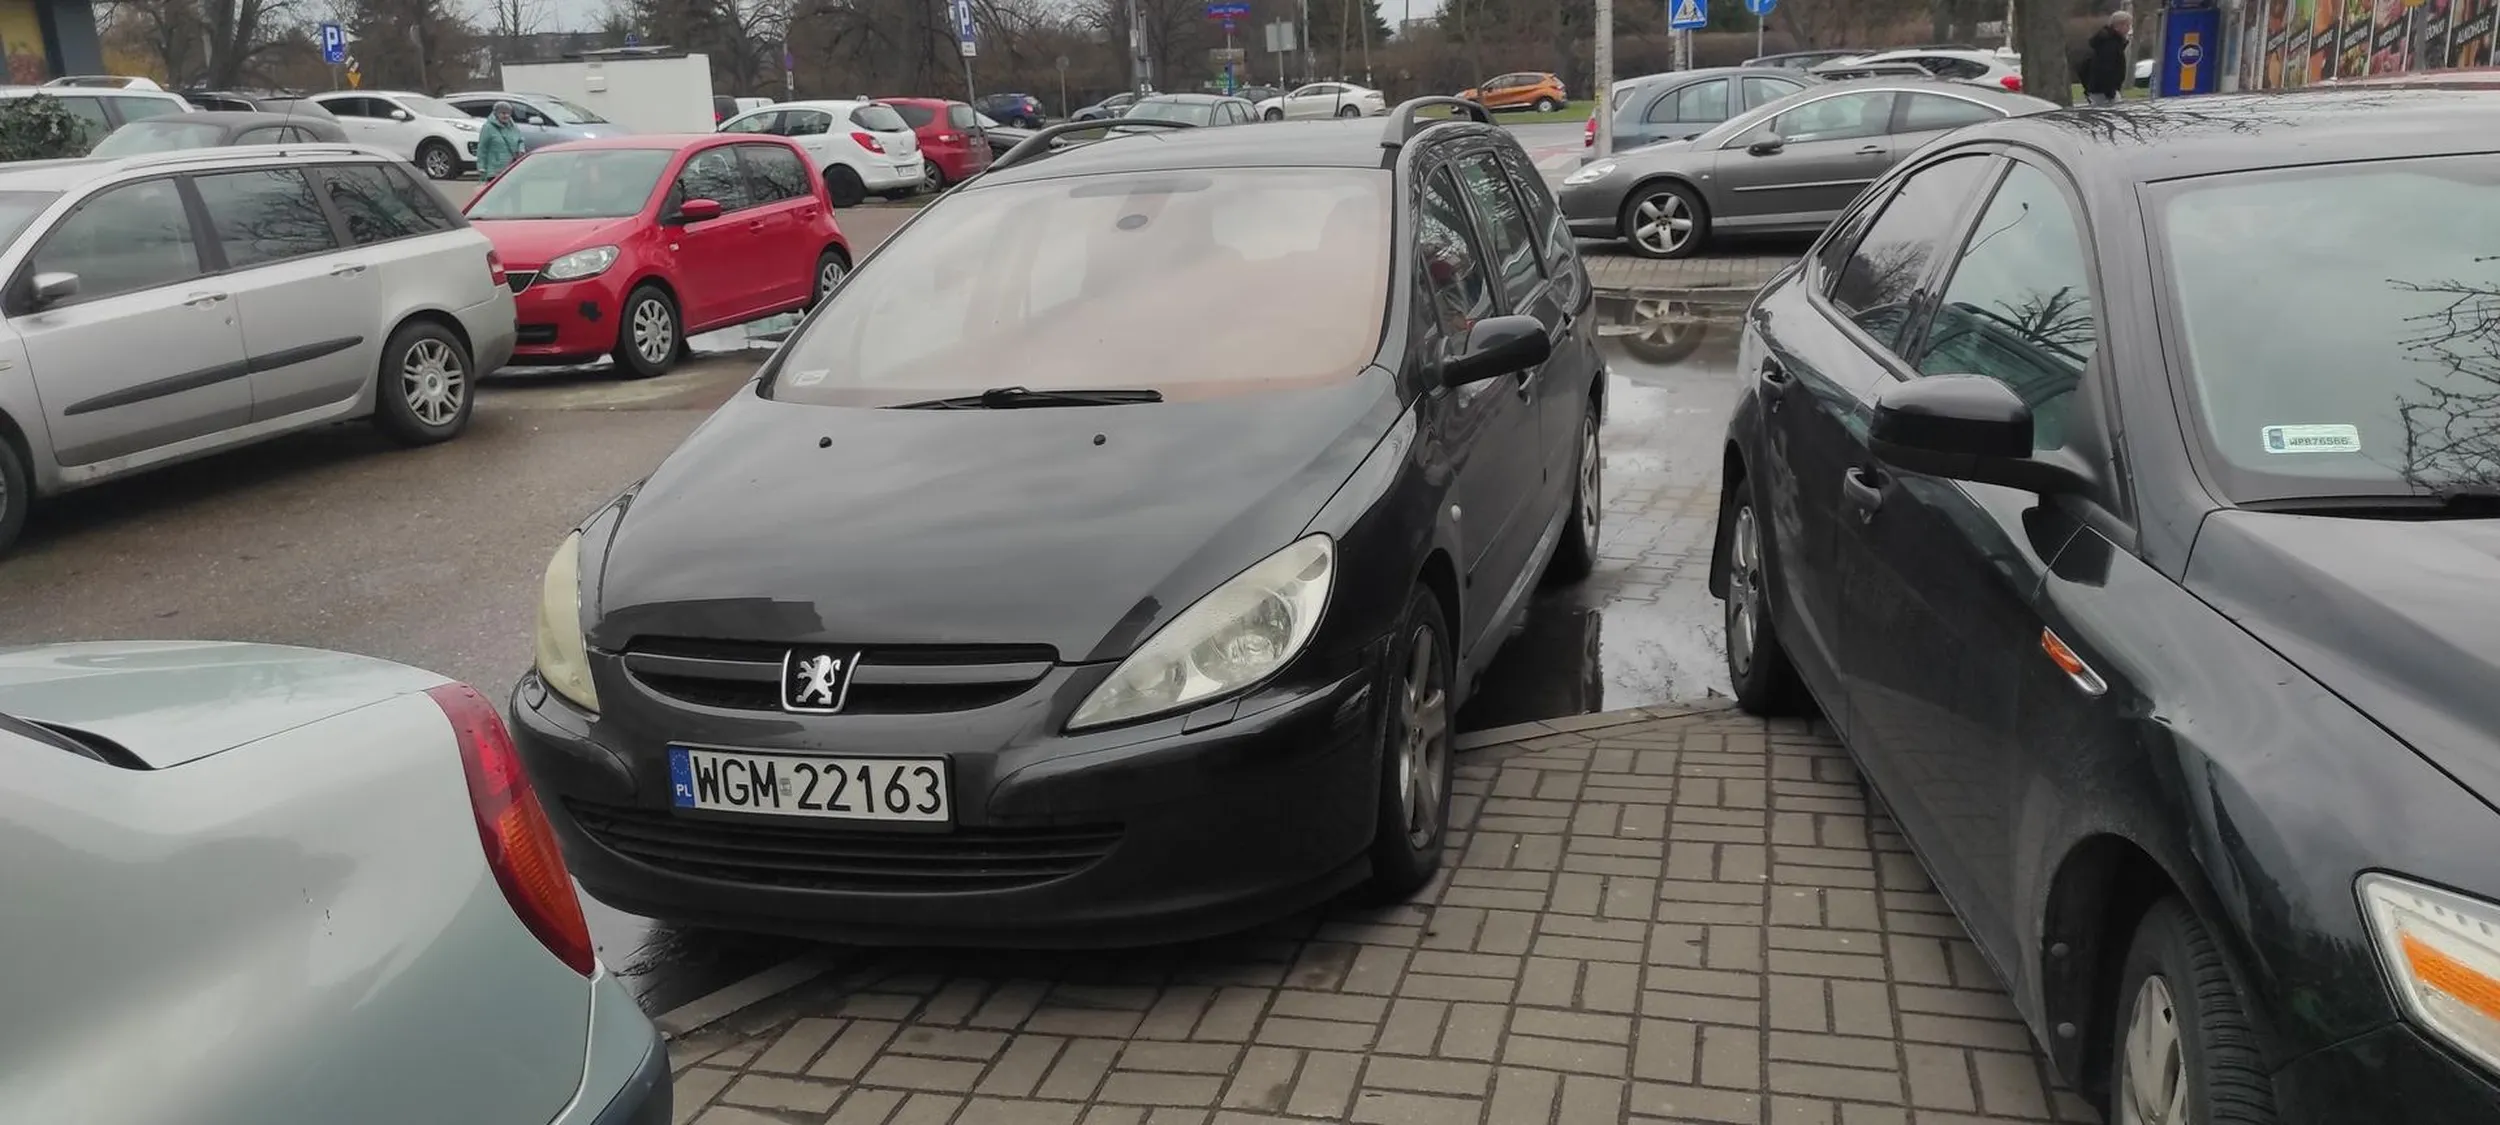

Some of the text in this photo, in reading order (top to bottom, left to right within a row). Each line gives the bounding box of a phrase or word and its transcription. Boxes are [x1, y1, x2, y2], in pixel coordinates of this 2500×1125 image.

[958, 0, 970, 35] P
[326, 26, 339, 51] P
[676, 784, 692, 797] PL
[693, 756, 942, 814] WGM 22163
